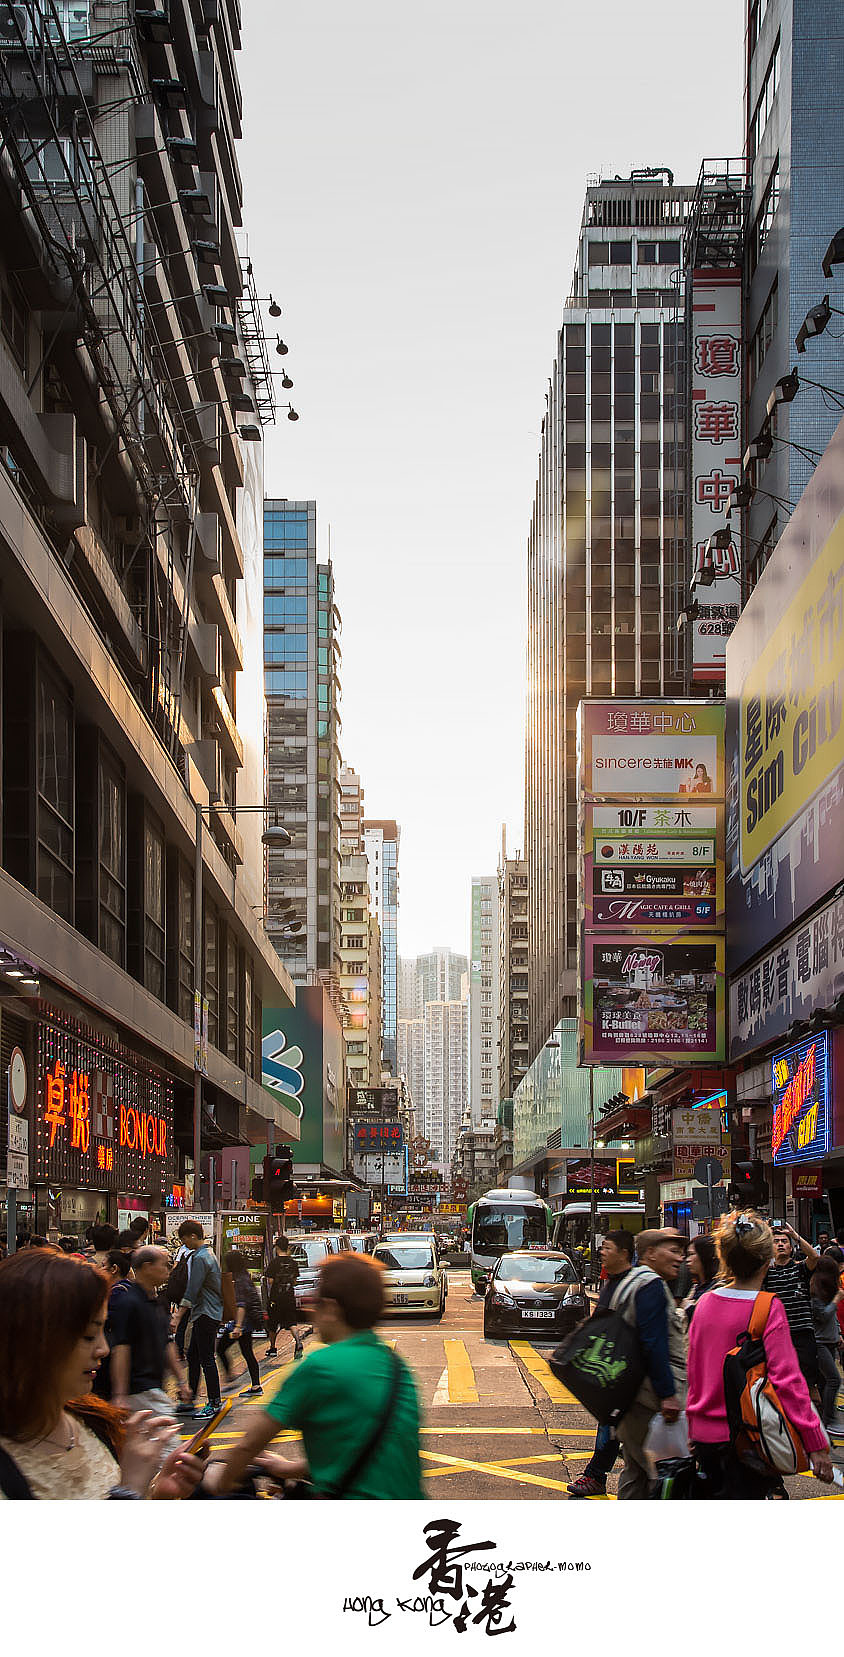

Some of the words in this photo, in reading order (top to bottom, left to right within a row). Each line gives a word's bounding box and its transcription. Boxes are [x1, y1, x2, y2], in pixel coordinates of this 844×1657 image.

[696, 335, 739, 579] 瓊華中心
[607, 711, 696, 733] 瓊華中心
[595, 758, 652, 769] sincere
[674, 758, 694, 769] MK
[746, 750, 784, 834] Sim
[618, 810, 646, 827] 10/F
[692, 846, 710, 856] 8/F
[646, 875, 676, 884] Gyukaku
[696, 906, 711, 914] 5/F
[622, 952, 660, 973] Neway
[737, 947, 790, 1025] 數碼影音
[120, 1104, 168, 1159] BONJOUR
[97, 1144, 113, 1171] 藥房
